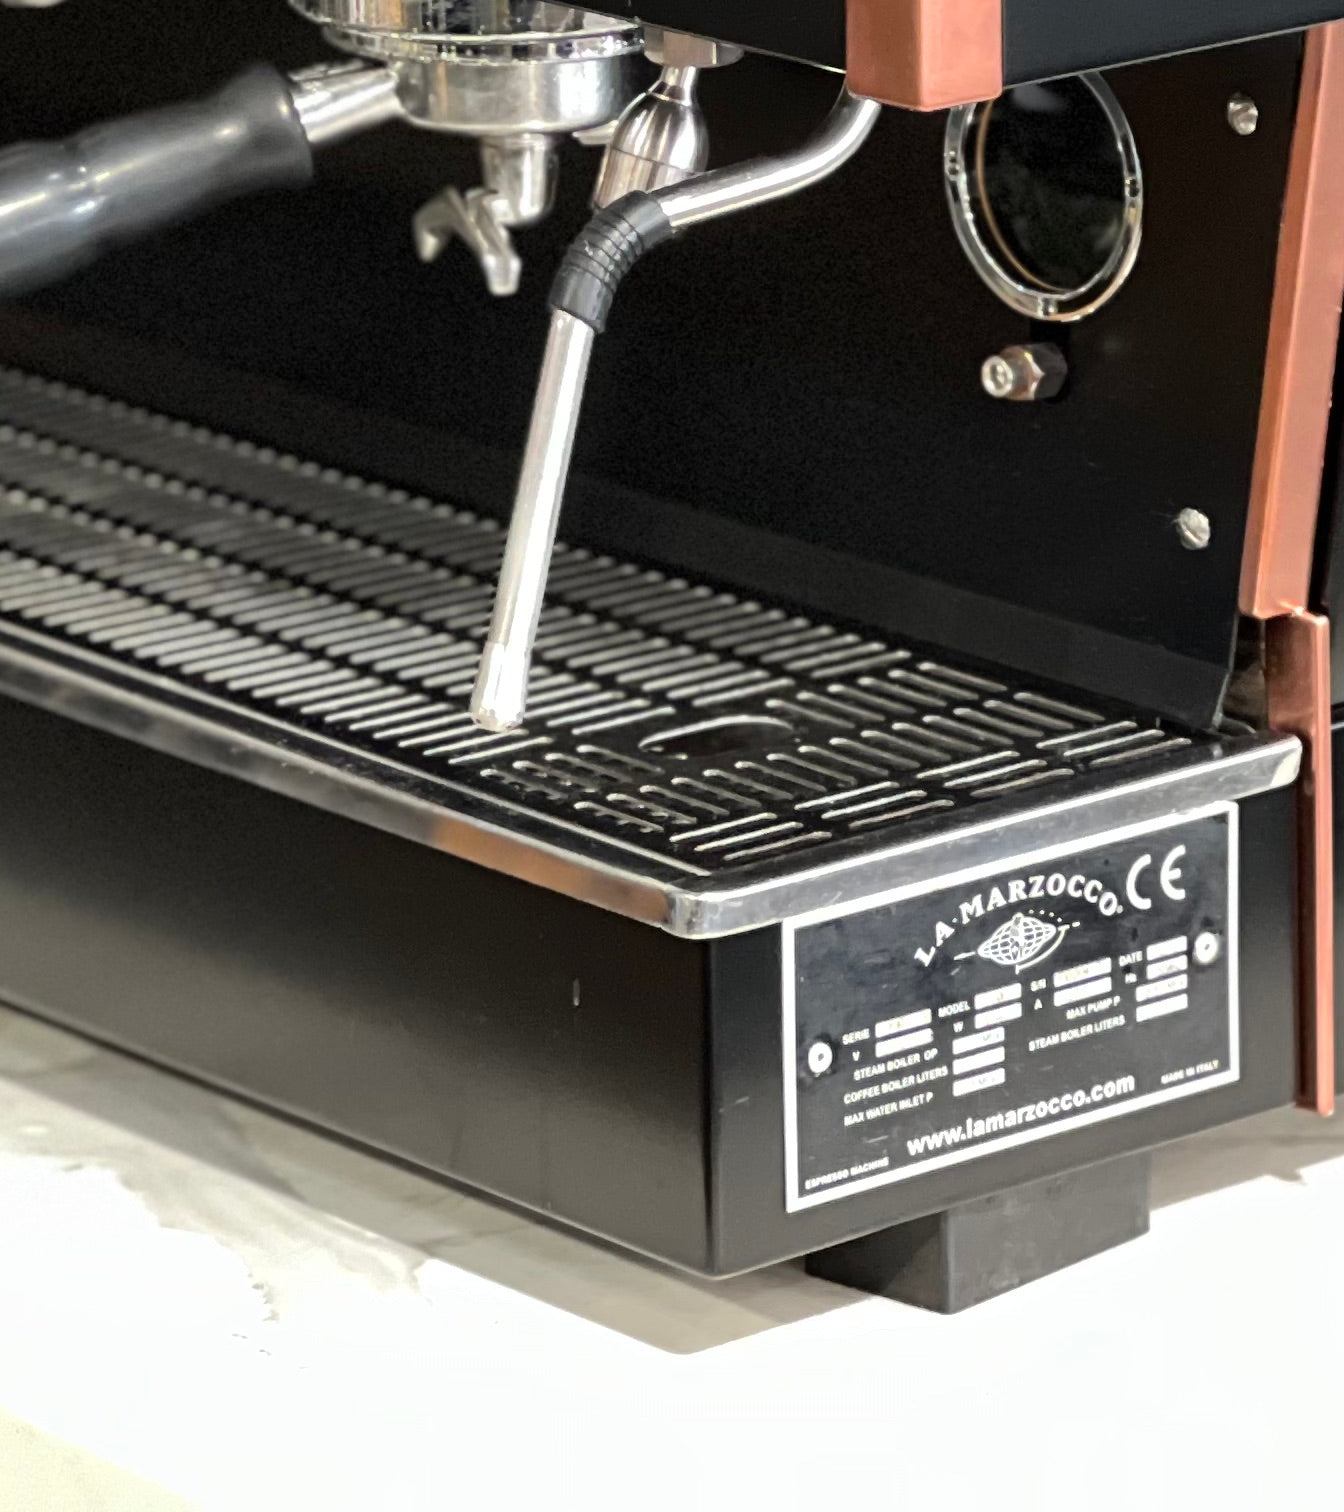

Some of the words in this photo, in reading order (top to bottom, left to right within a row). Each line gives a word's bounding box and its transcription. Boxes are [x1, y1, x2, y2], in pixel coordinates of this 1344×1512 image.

[914, 921, 955, 967] LA
[959, 873, 1118, 924] MARZOCCO
[1118, 951, 1143, 967] DATE
[938, 1001, 970, 1018] MODEL
[1034, 998, 1043, 1010] A
[1066, 1005, 1086, 1020] MAX
[1087, 998, 1112, 1015] PUMP
[1114, 995, 1121, 1007] P
[953, 1021, 964, 1032] W
[1028, 1034, 1059, 1051] STEAM
[1061, 1024, 1093, 1042] BOILER
[1094, 1014, 1125, 1033] LITERS
[854, 1063, 886, 1081] STEAM
[887, 1053, 921, 1072] BOILER
[1196, 1059, 1219, 1074] ITALY
[843, 1085, 880, 1105] COFFEE
[881, 1075, 915, 1094] BOILER
[916, 1065, 948, 1083] LITERS
[843, 1111, 865, 1127] MAX
[866, 1102, 898, 1120] WATER
[899, 1094, 924, 1110] INLET
[926, 1092, 934, 1103] P
[907, 1074, 1136, 1156] www.lamarzocco.com
